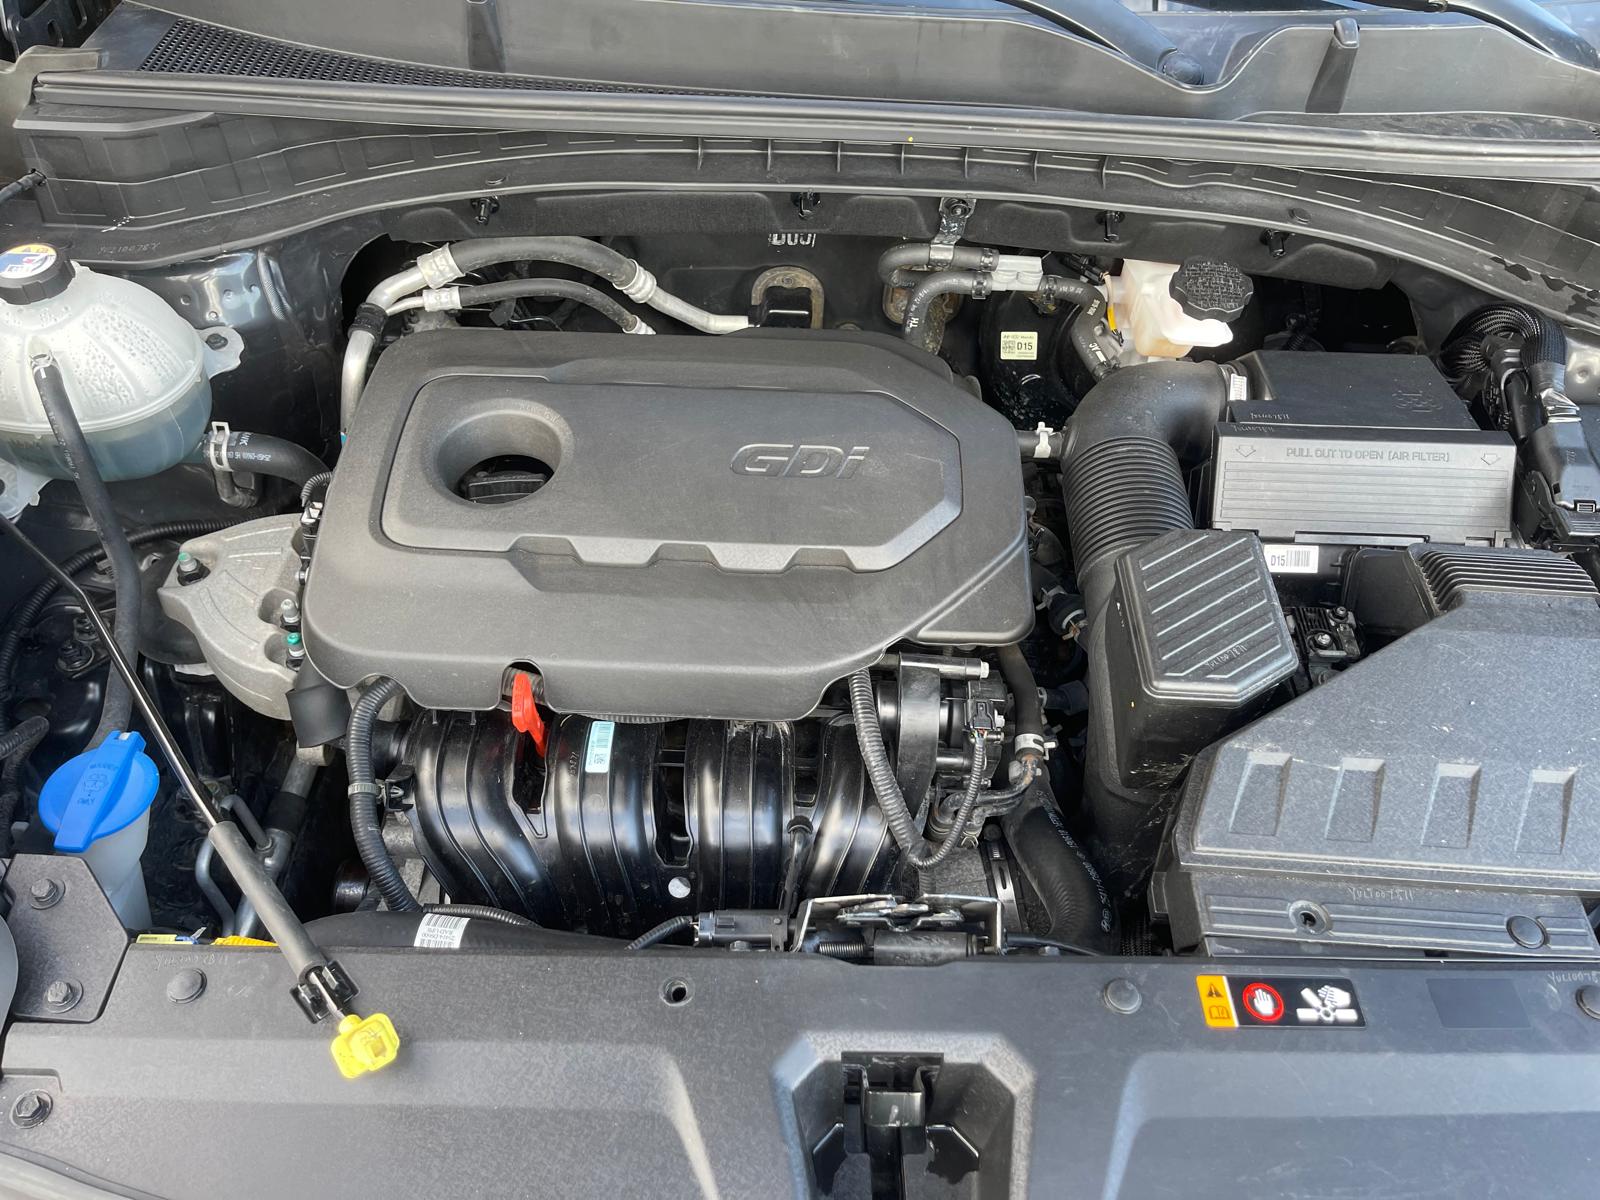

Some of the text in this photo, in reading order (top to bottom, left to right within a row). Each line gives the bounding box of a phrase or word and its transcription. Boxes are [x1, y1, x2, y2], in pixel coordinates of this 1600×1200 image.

[909, 317, 919, 328] TH
[1016, 341, 1033, 351] D15
[1286, 447, 1313, 458] PULL
[1314, 447, 1337, 458] OUT
[1338, 448, 1353, 459] TO
[1354, 449, 1384, 460] OPEN
[729, 443, 870, 480] GDi
[1270, 554, 1286, 567] D15
